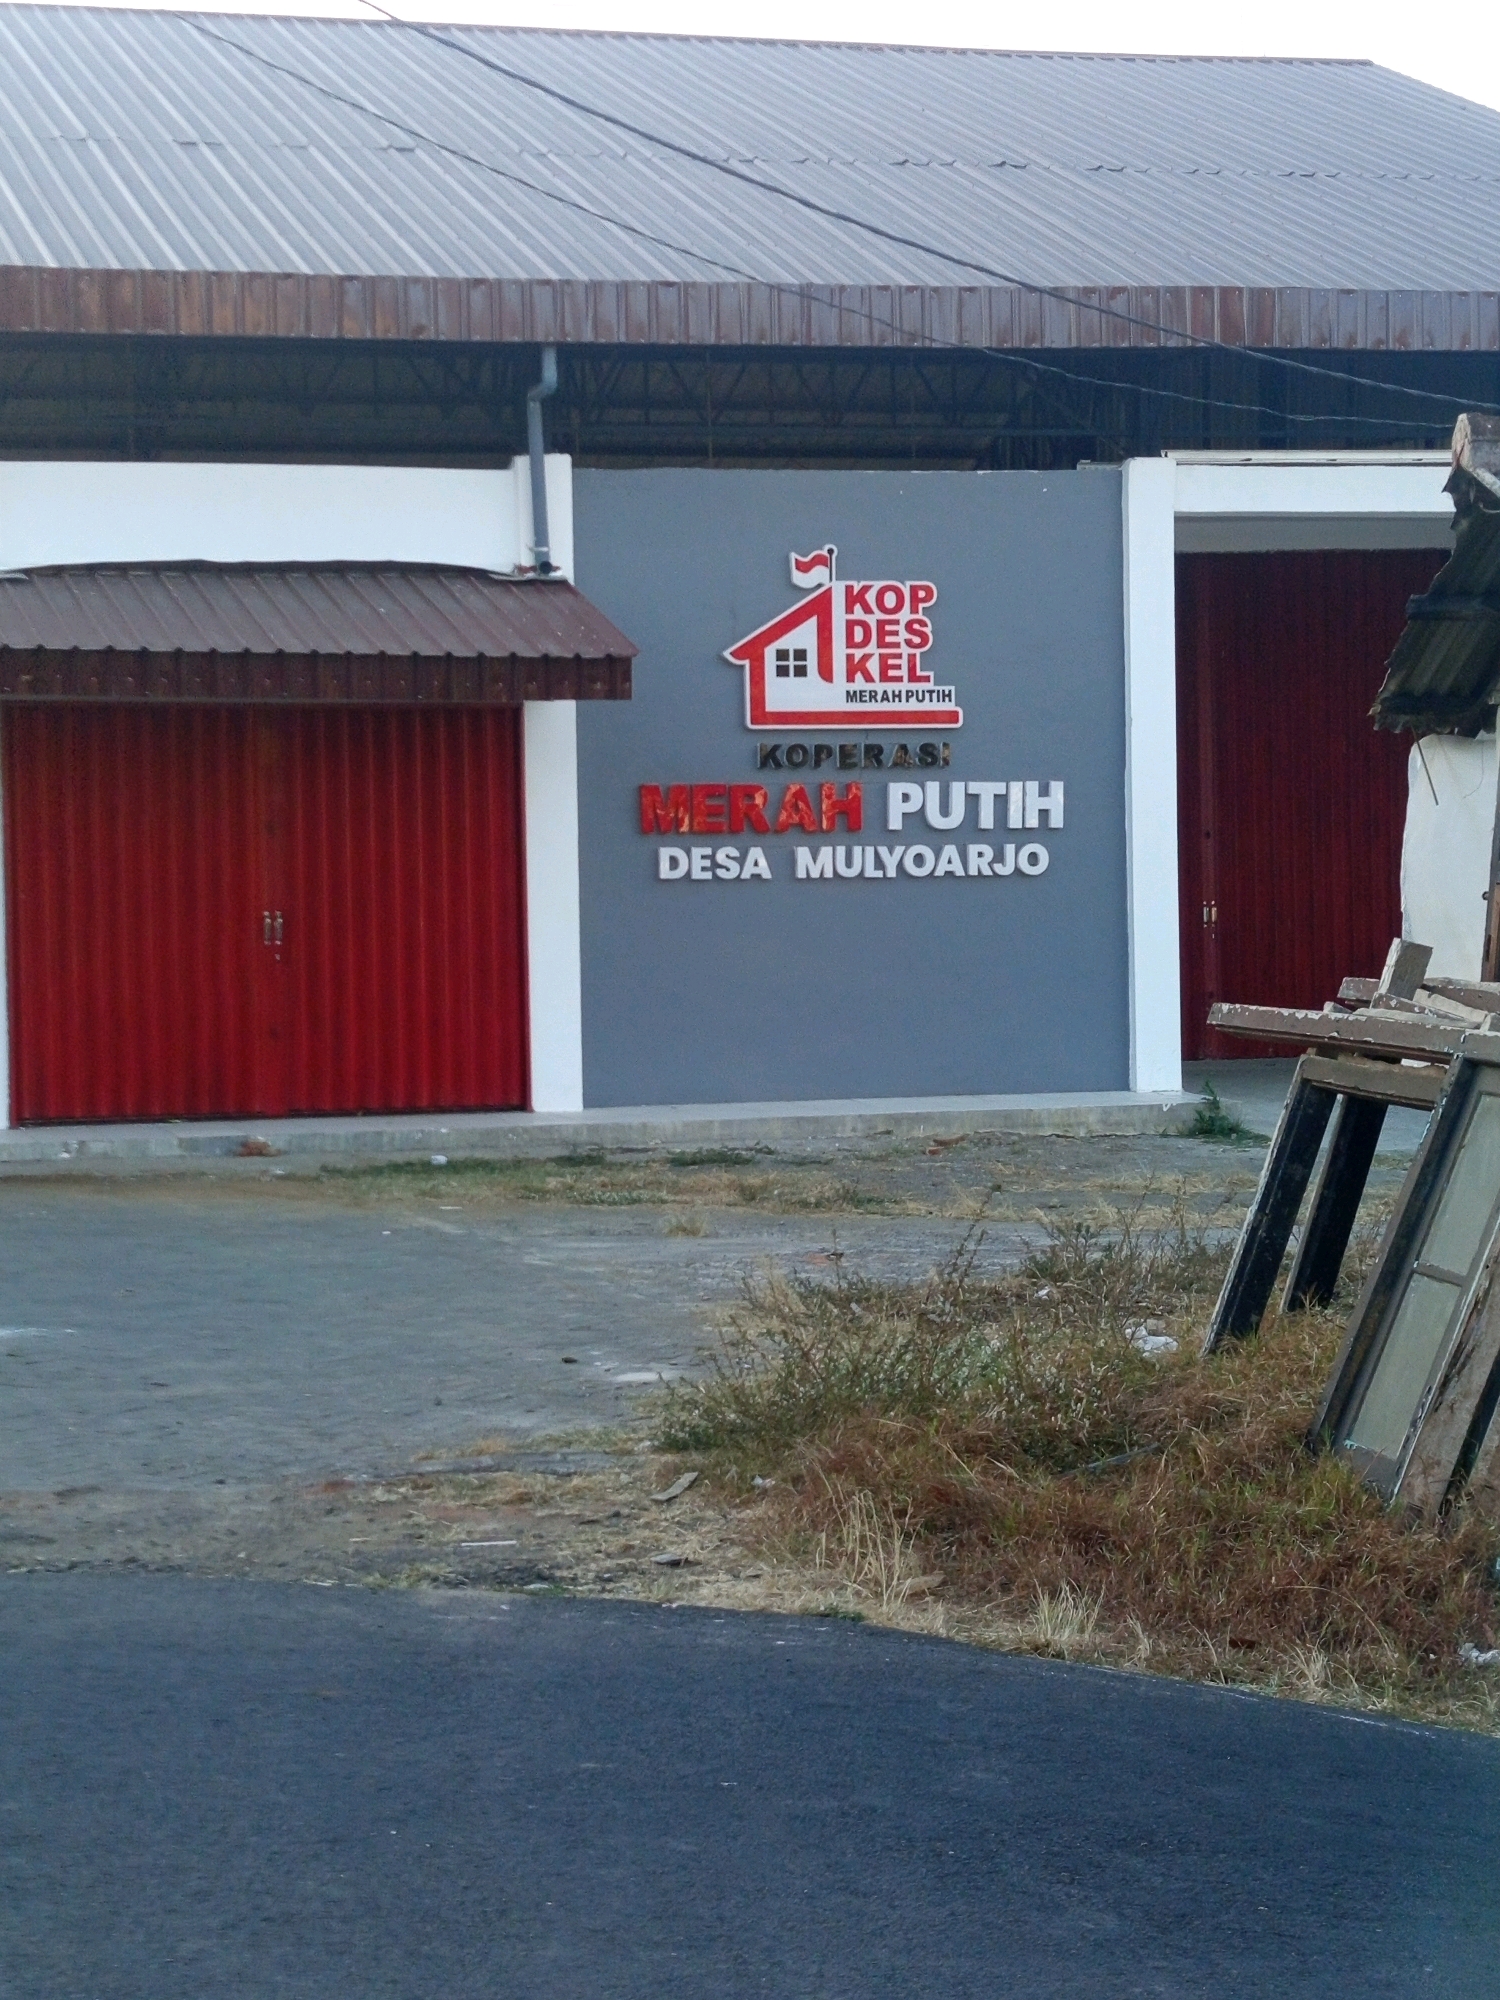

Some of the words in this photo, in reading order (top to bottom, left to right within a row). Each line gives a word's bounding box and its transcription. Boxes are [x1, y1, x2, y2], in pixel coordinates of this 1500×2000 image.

[845, 583, 935, 615] KOP
[845, 618, 931, 650] DES
[845, 652, 931, 684] KEL
[845, 689, 903, 704] MERAH
[905, 688, 953, 703] PUTIH
[757, 742, 951, 770] KOPERASI
[639, 781, 864, 835] MERAH
[886, 780, 1065, 831] PUTIH
[658, 846, 772, 881] DESA
[794, 843, 1050, 880] MULYOARJO
